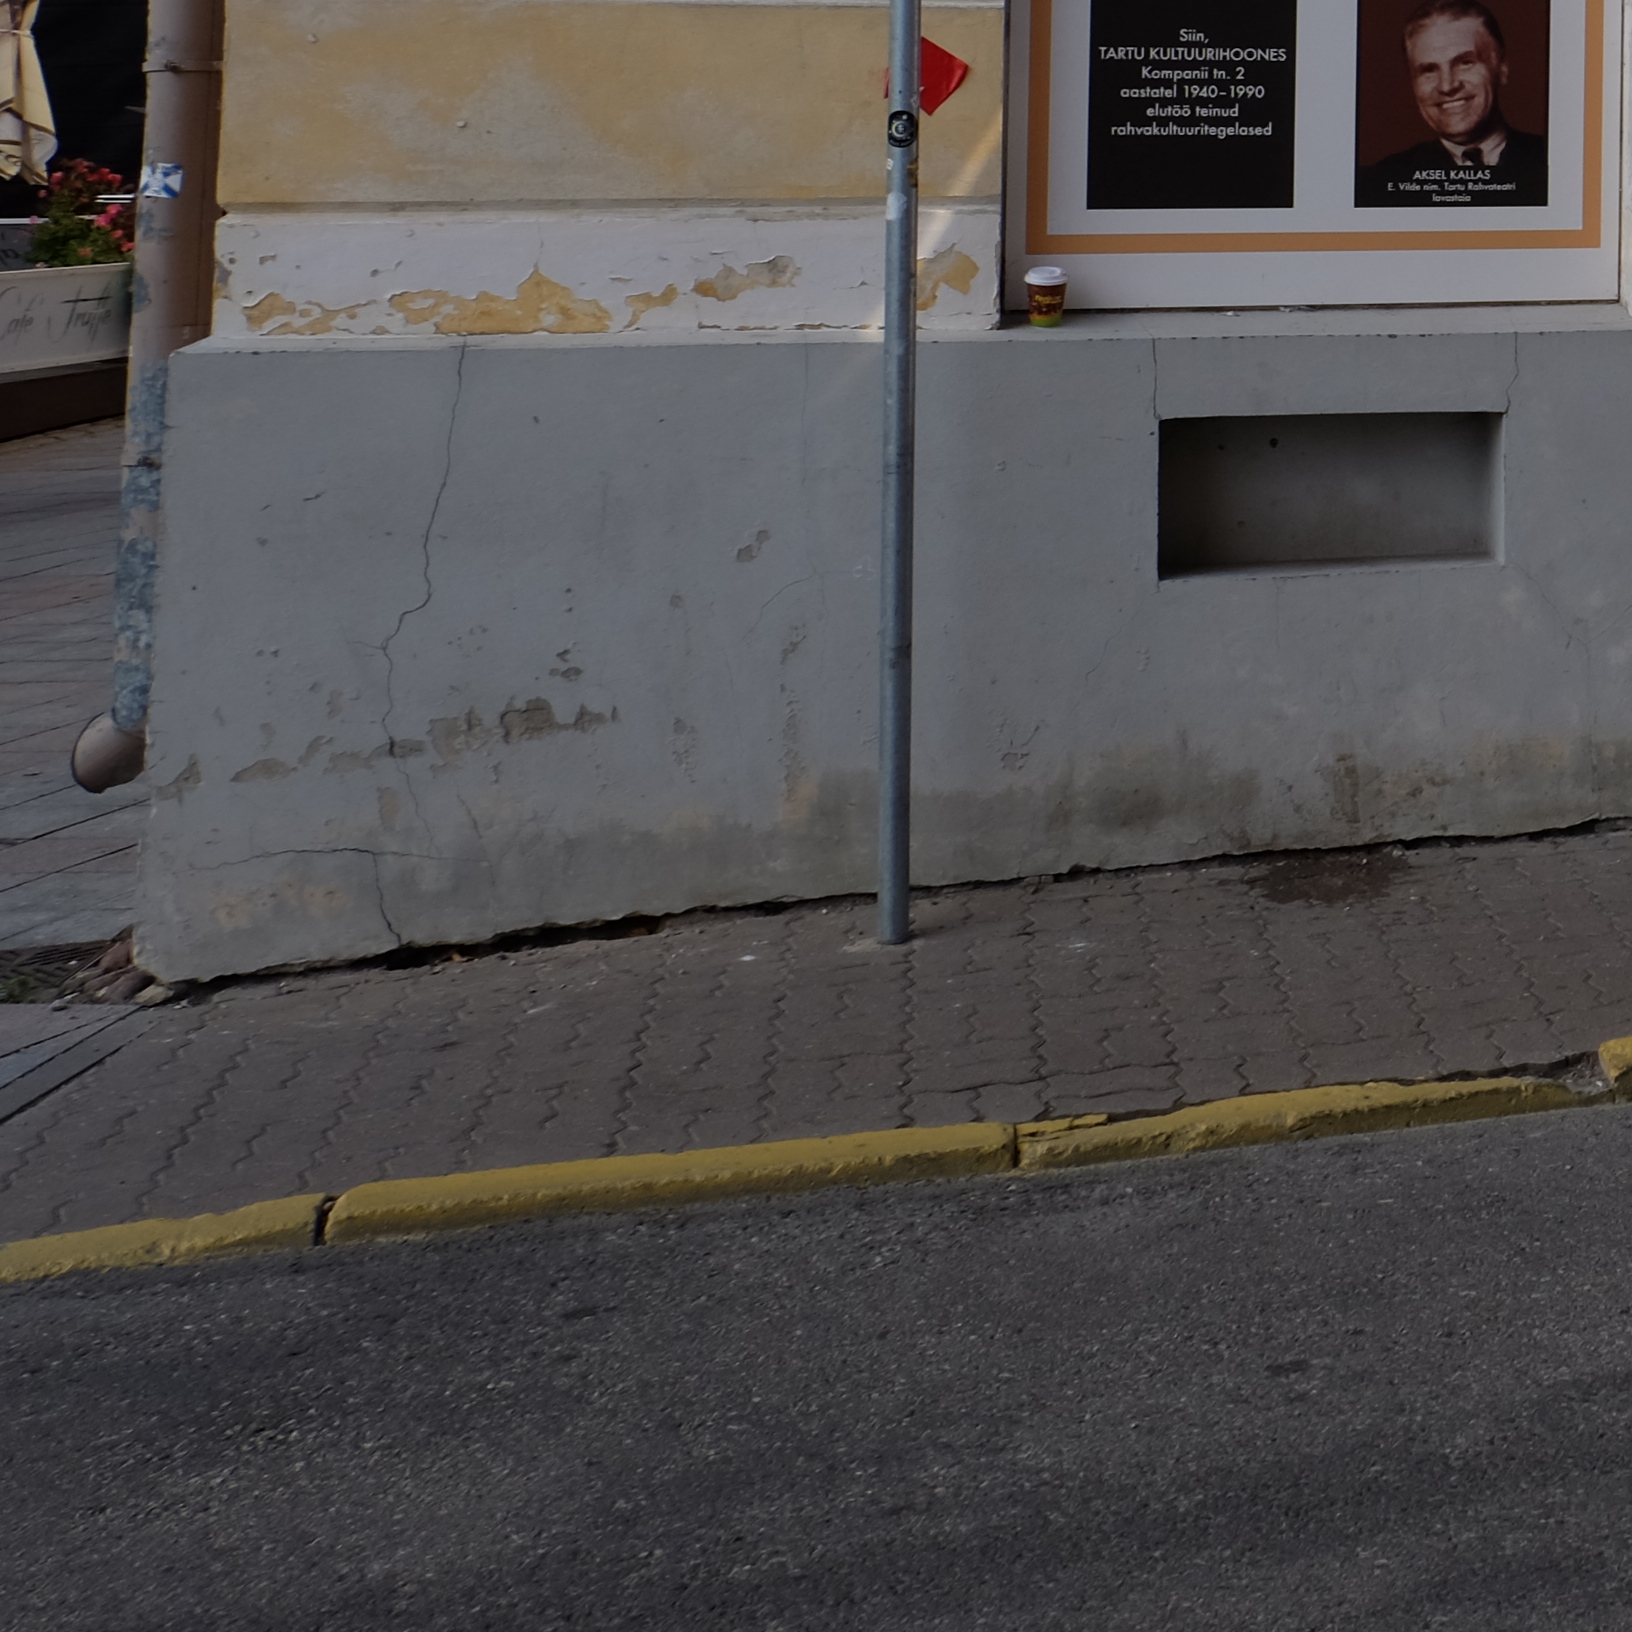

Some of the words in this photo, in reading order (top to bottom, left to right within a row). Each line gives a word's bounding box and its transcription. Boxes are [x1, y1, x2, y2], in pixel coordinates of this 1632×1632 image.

[1179, 29, 1209, 43] Siin,
[1098, 47, 1144, 60] TARTU
[1149, 48, 1287, 61] KULTUURIHOONES
[1141, 66, 1208, 82] Kompanii
[1213, 68, 1230, 79] tn.
[1236, 67, 1245, 79] 2
[1120, 84, 1177, 98] aastatel
[1146, 103, 1191, 116] elutöö
[1195, 104, 1239, 117] teinud
[1111, 122, 1272, 139] rahvakultuuritegelased
[1413, 170, 1447, 179] AKSEL
[1450, 170, 1491, 179] KALLAS
[1388, 183, 1396, 191] E.
[1398, 183, 1420, 191] Vilde
[1423, 183, 1441, 191] nim.
[1444, 183, 1465, 191] Tartu
[1468, 182, 1516, 190] Rahvateatri
